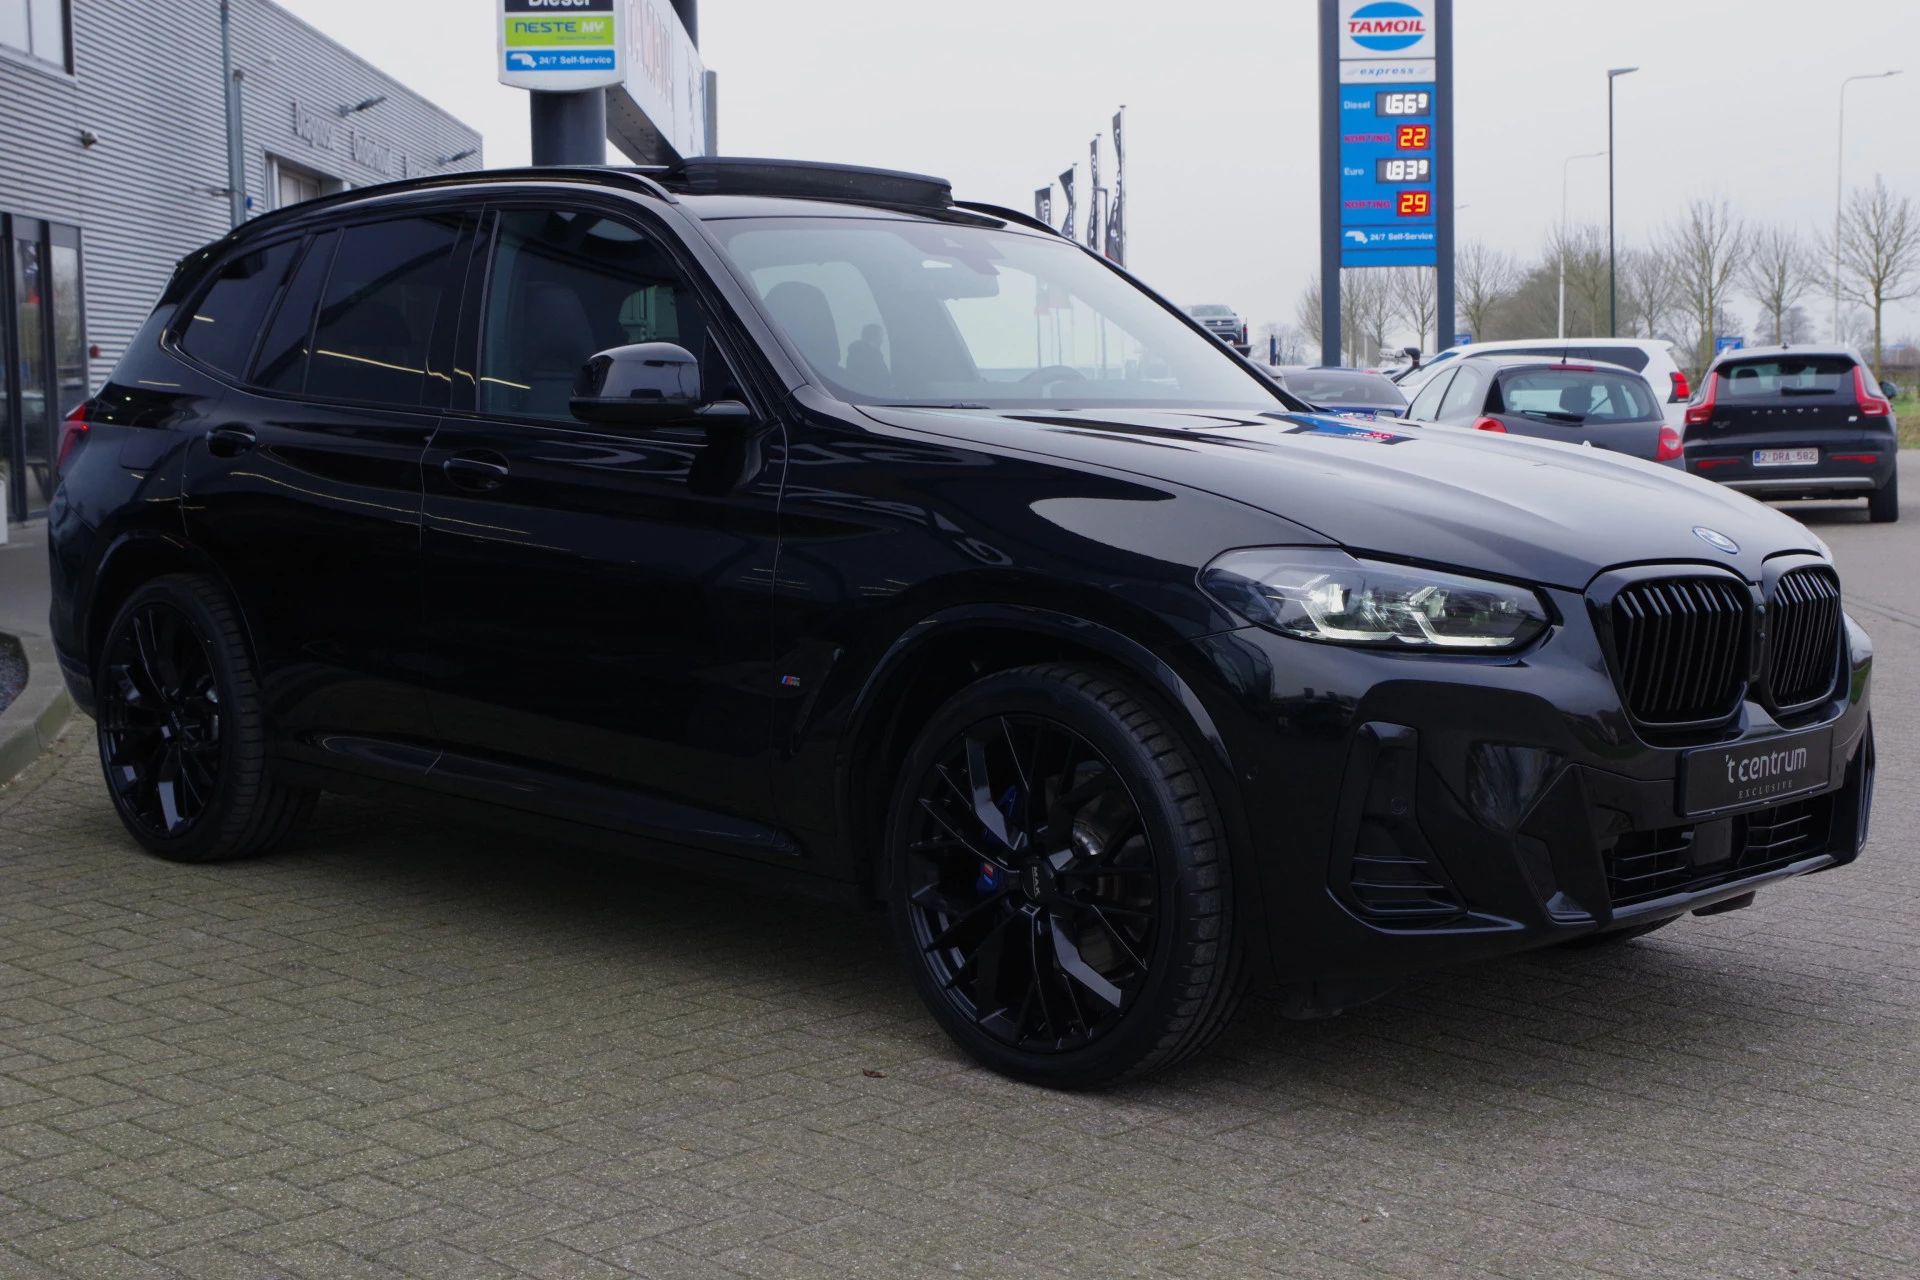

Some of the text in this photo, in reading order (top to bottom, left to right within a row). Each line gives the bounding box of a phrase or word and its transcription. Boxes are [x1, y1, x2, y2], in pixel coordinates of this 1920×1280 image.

[514, 21, 577, 34] NESTE
[1348, 20, 1426, 33] TAMOIL
[560, 55, 612, 65] Self-Service
[1360, 67, 1414, 76] express
[1344, 101, 1370, 109] Diesel
[1344, 128, 1426, 147] KORTING 22
[1344, 168, 1364, 176] Euro
[1344, 194, 1427, 213] KORTING 29
[1388, 232, 1434, 241] Self-Service
[1738, 747, 1807, 782] centrum
[1738, 779, 1794, 799] EXCLUSIVE
